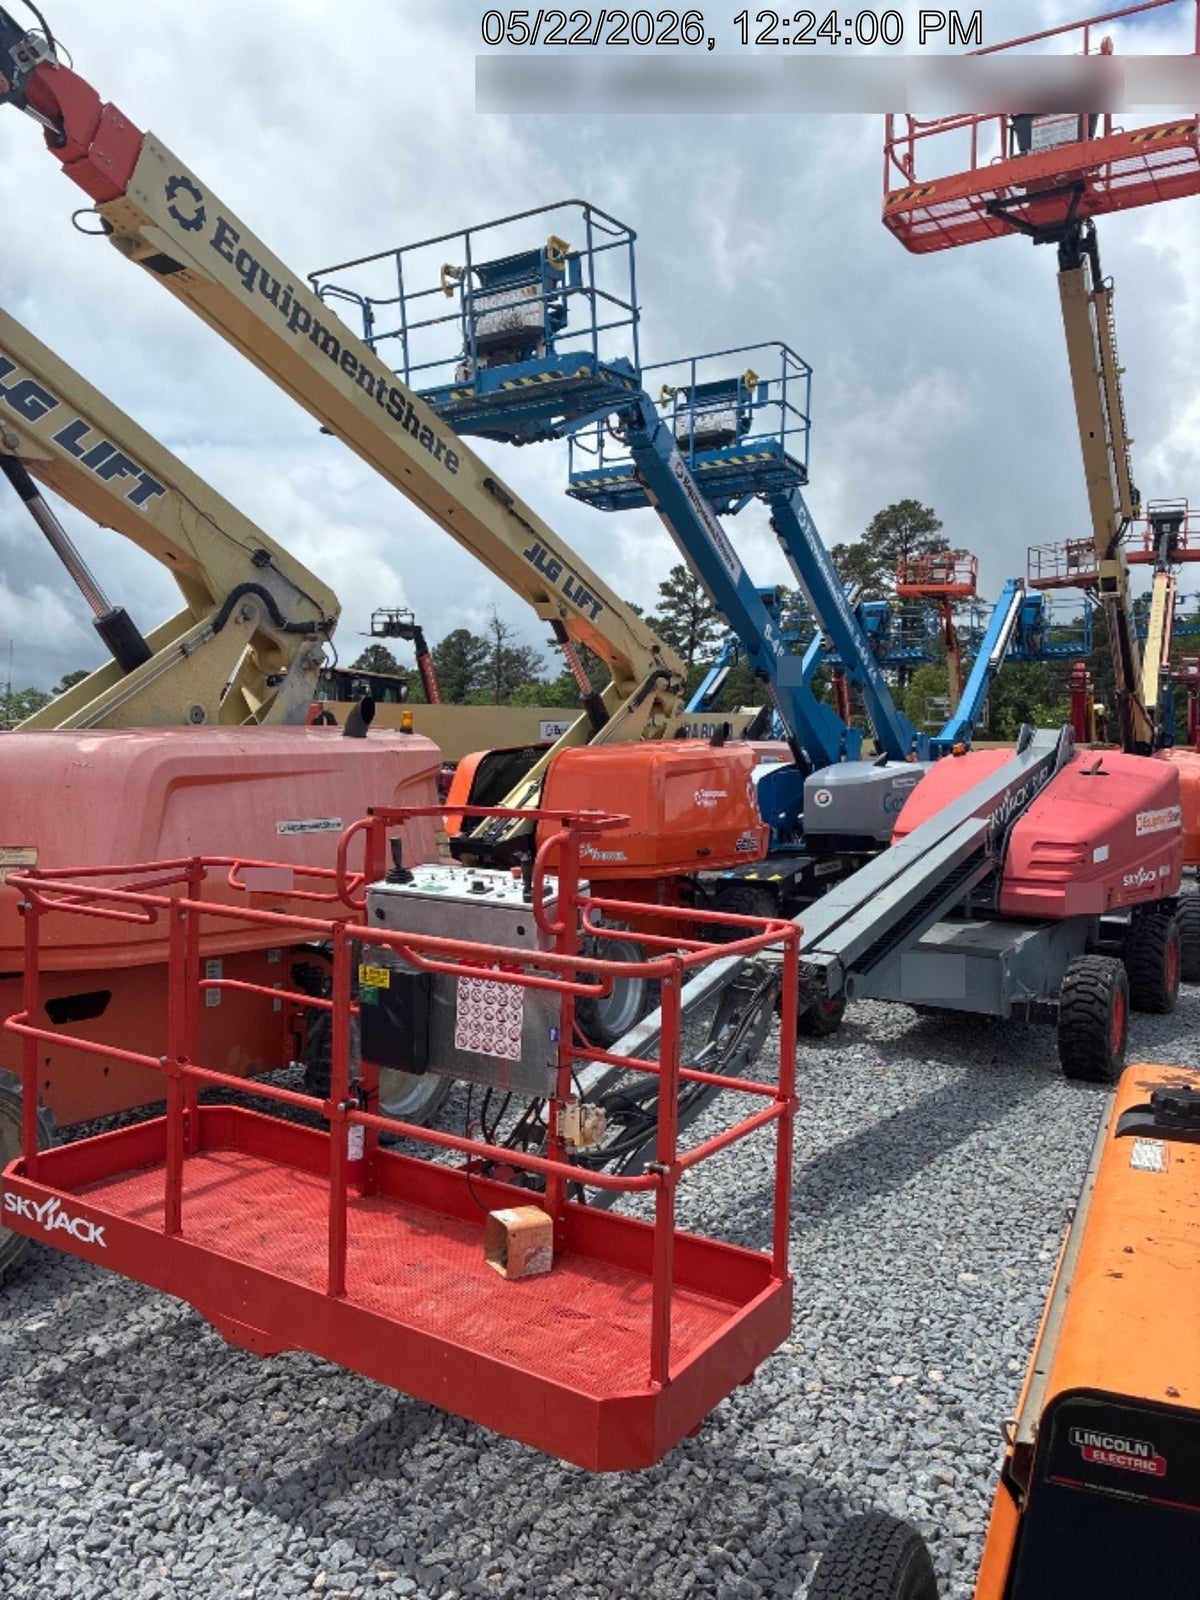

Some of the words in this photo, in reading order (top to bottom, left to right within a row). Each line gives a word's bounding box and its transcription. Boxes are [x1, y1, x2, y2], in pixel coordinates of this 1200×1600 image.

[209, 215, 460, 475] EquipmentShare
[50, 417, 168, 510] LIFT
[522, 542, 565, 584] JLG
[561, 575, 604, 622] LIFT
[4, 1192, 107, 1248] SKYJACK
[1074, 1431, 1148, 1457] LINCOLN
[1093, 1449, 1158, 1471] ELECTRIC
